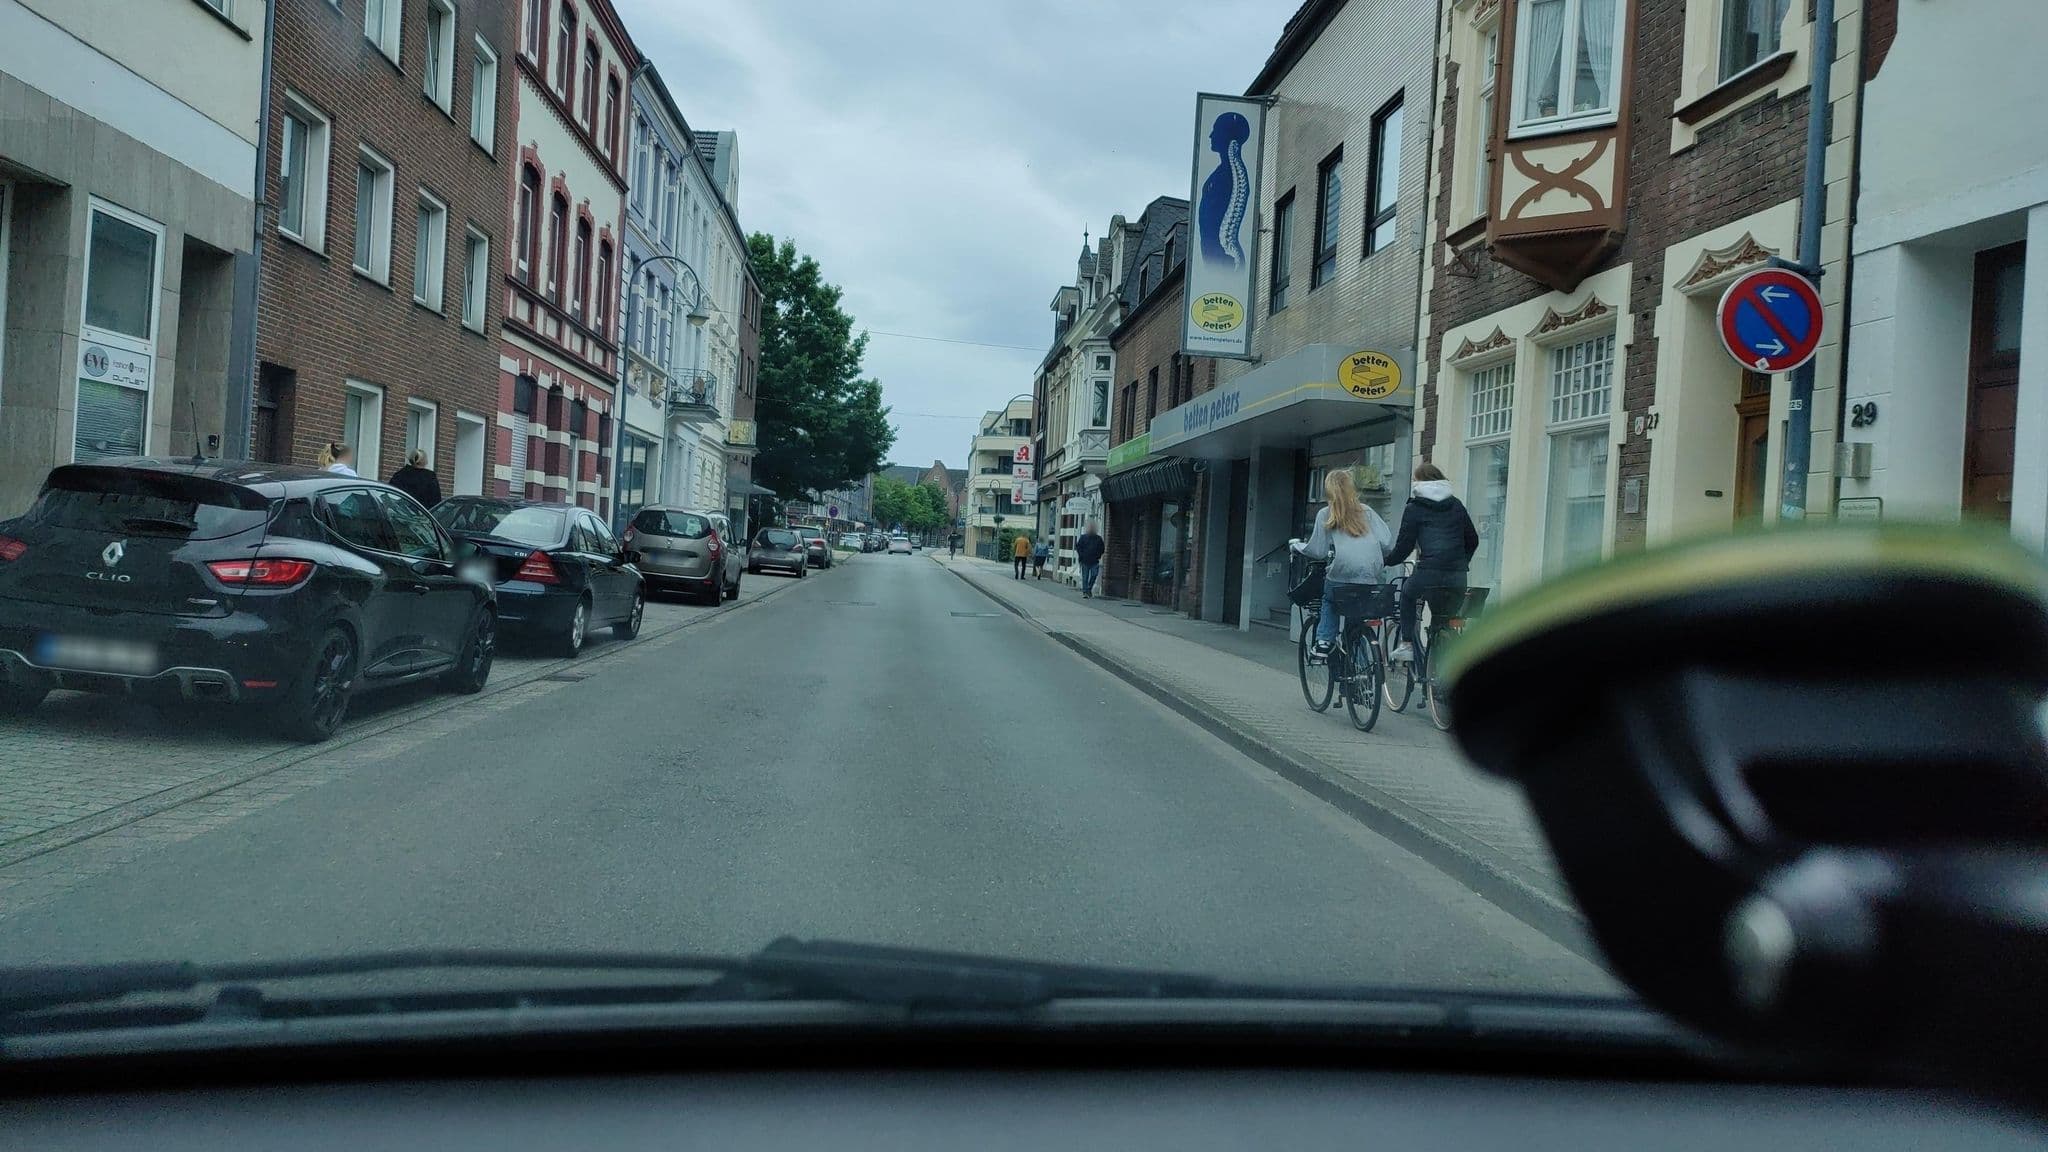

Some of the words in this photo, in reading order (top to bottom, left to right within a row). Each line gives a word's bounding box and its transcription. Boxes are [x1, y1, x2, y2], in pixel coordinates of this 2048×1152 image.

[1203, 297, 1233, 307] betten
[1203, 321, 1231, 329] peters
[1352, 356, 1388, 368] betten
[113, 375, 144, 385] OUTLET
[1352, 385, 1385, 395] peters
[1184, 403, 1208, 432] betten
[1209, 391, 1240, 431] peters
[1851, 402, 1877, 429] 29
[86, 571, 131, 582] CLIO
